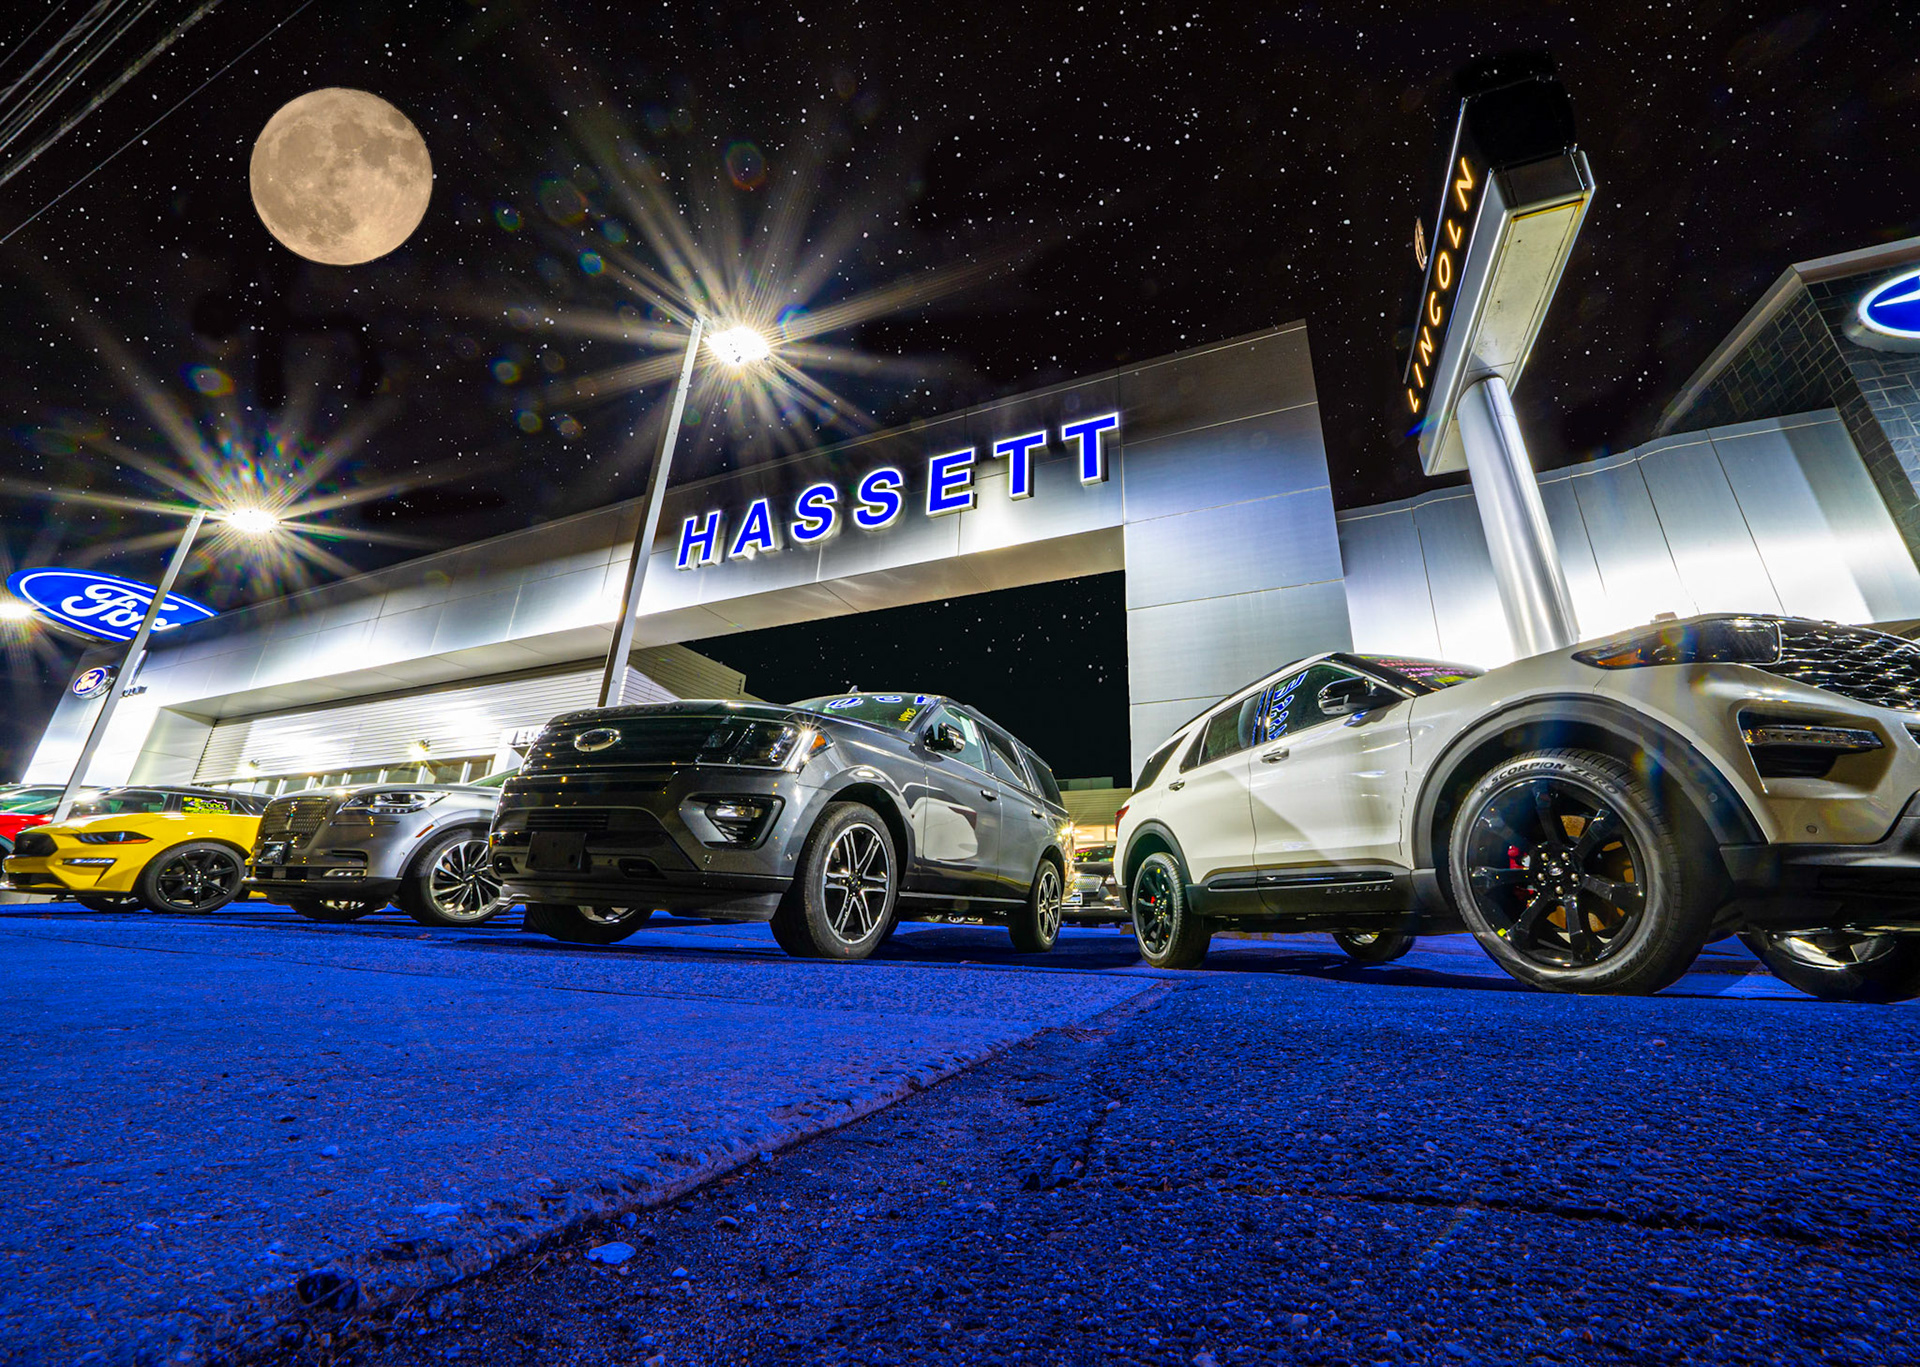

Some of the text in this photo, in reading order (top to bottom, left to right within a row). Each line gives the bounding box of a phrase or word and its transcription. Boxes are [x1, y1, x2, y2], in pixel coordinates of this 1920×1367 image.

[1408, 157, 1473, 413] LINCOLN
[675, 411, 1119, 571] HASSETT
[60, 583, 182, 631] For
[1491, 762, 1620, 795] SCORPION ZERO
